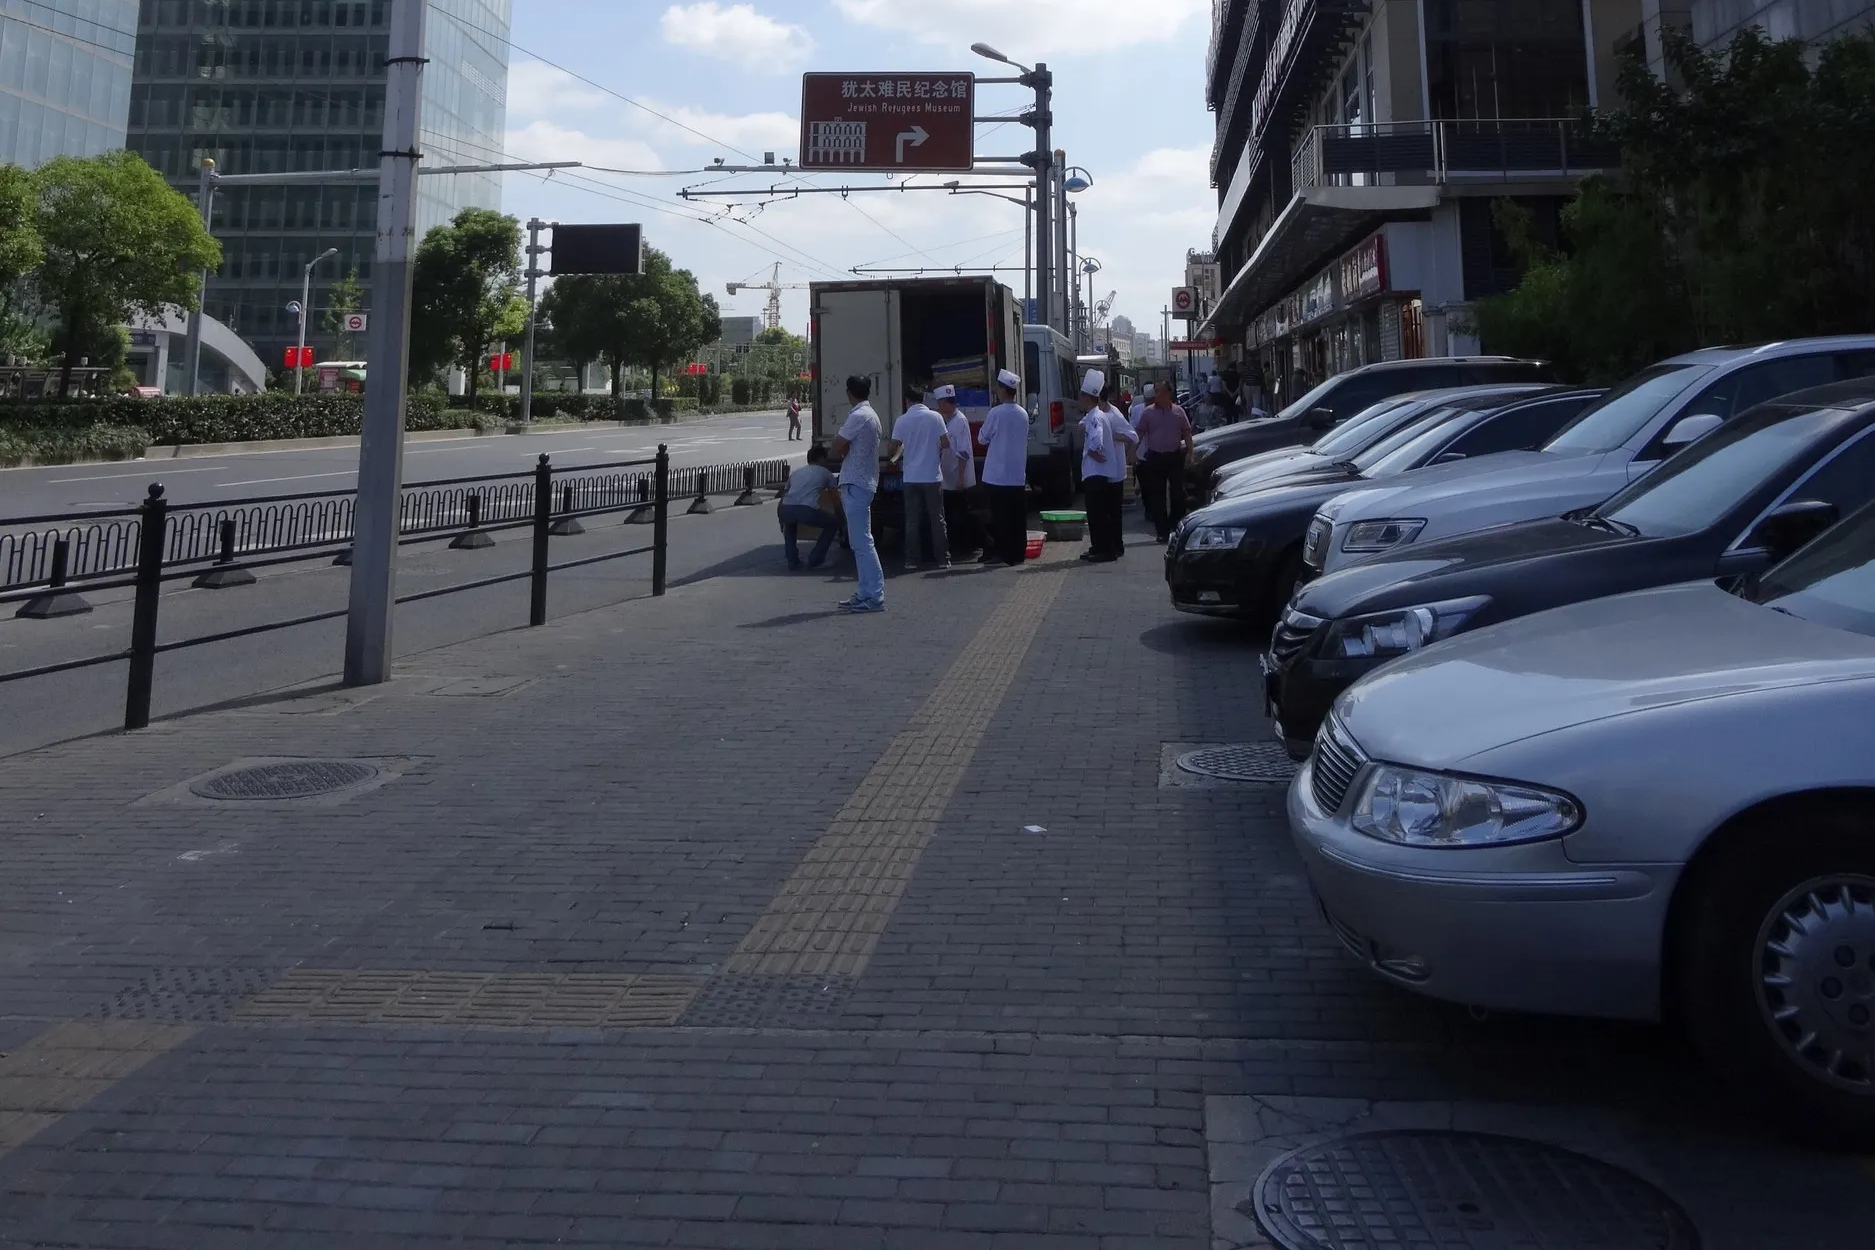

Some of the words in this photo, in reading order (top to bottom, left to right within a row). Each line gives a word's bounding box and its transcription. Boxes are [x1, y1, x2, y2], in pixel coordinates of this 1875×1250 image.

[841, 80, 967, 98] 犹太难民纪念馆
[847, 102, 877, 112] Jewish
[881, 102, 921, 114] Refugees
[925, 102, 960, 112] Museum
